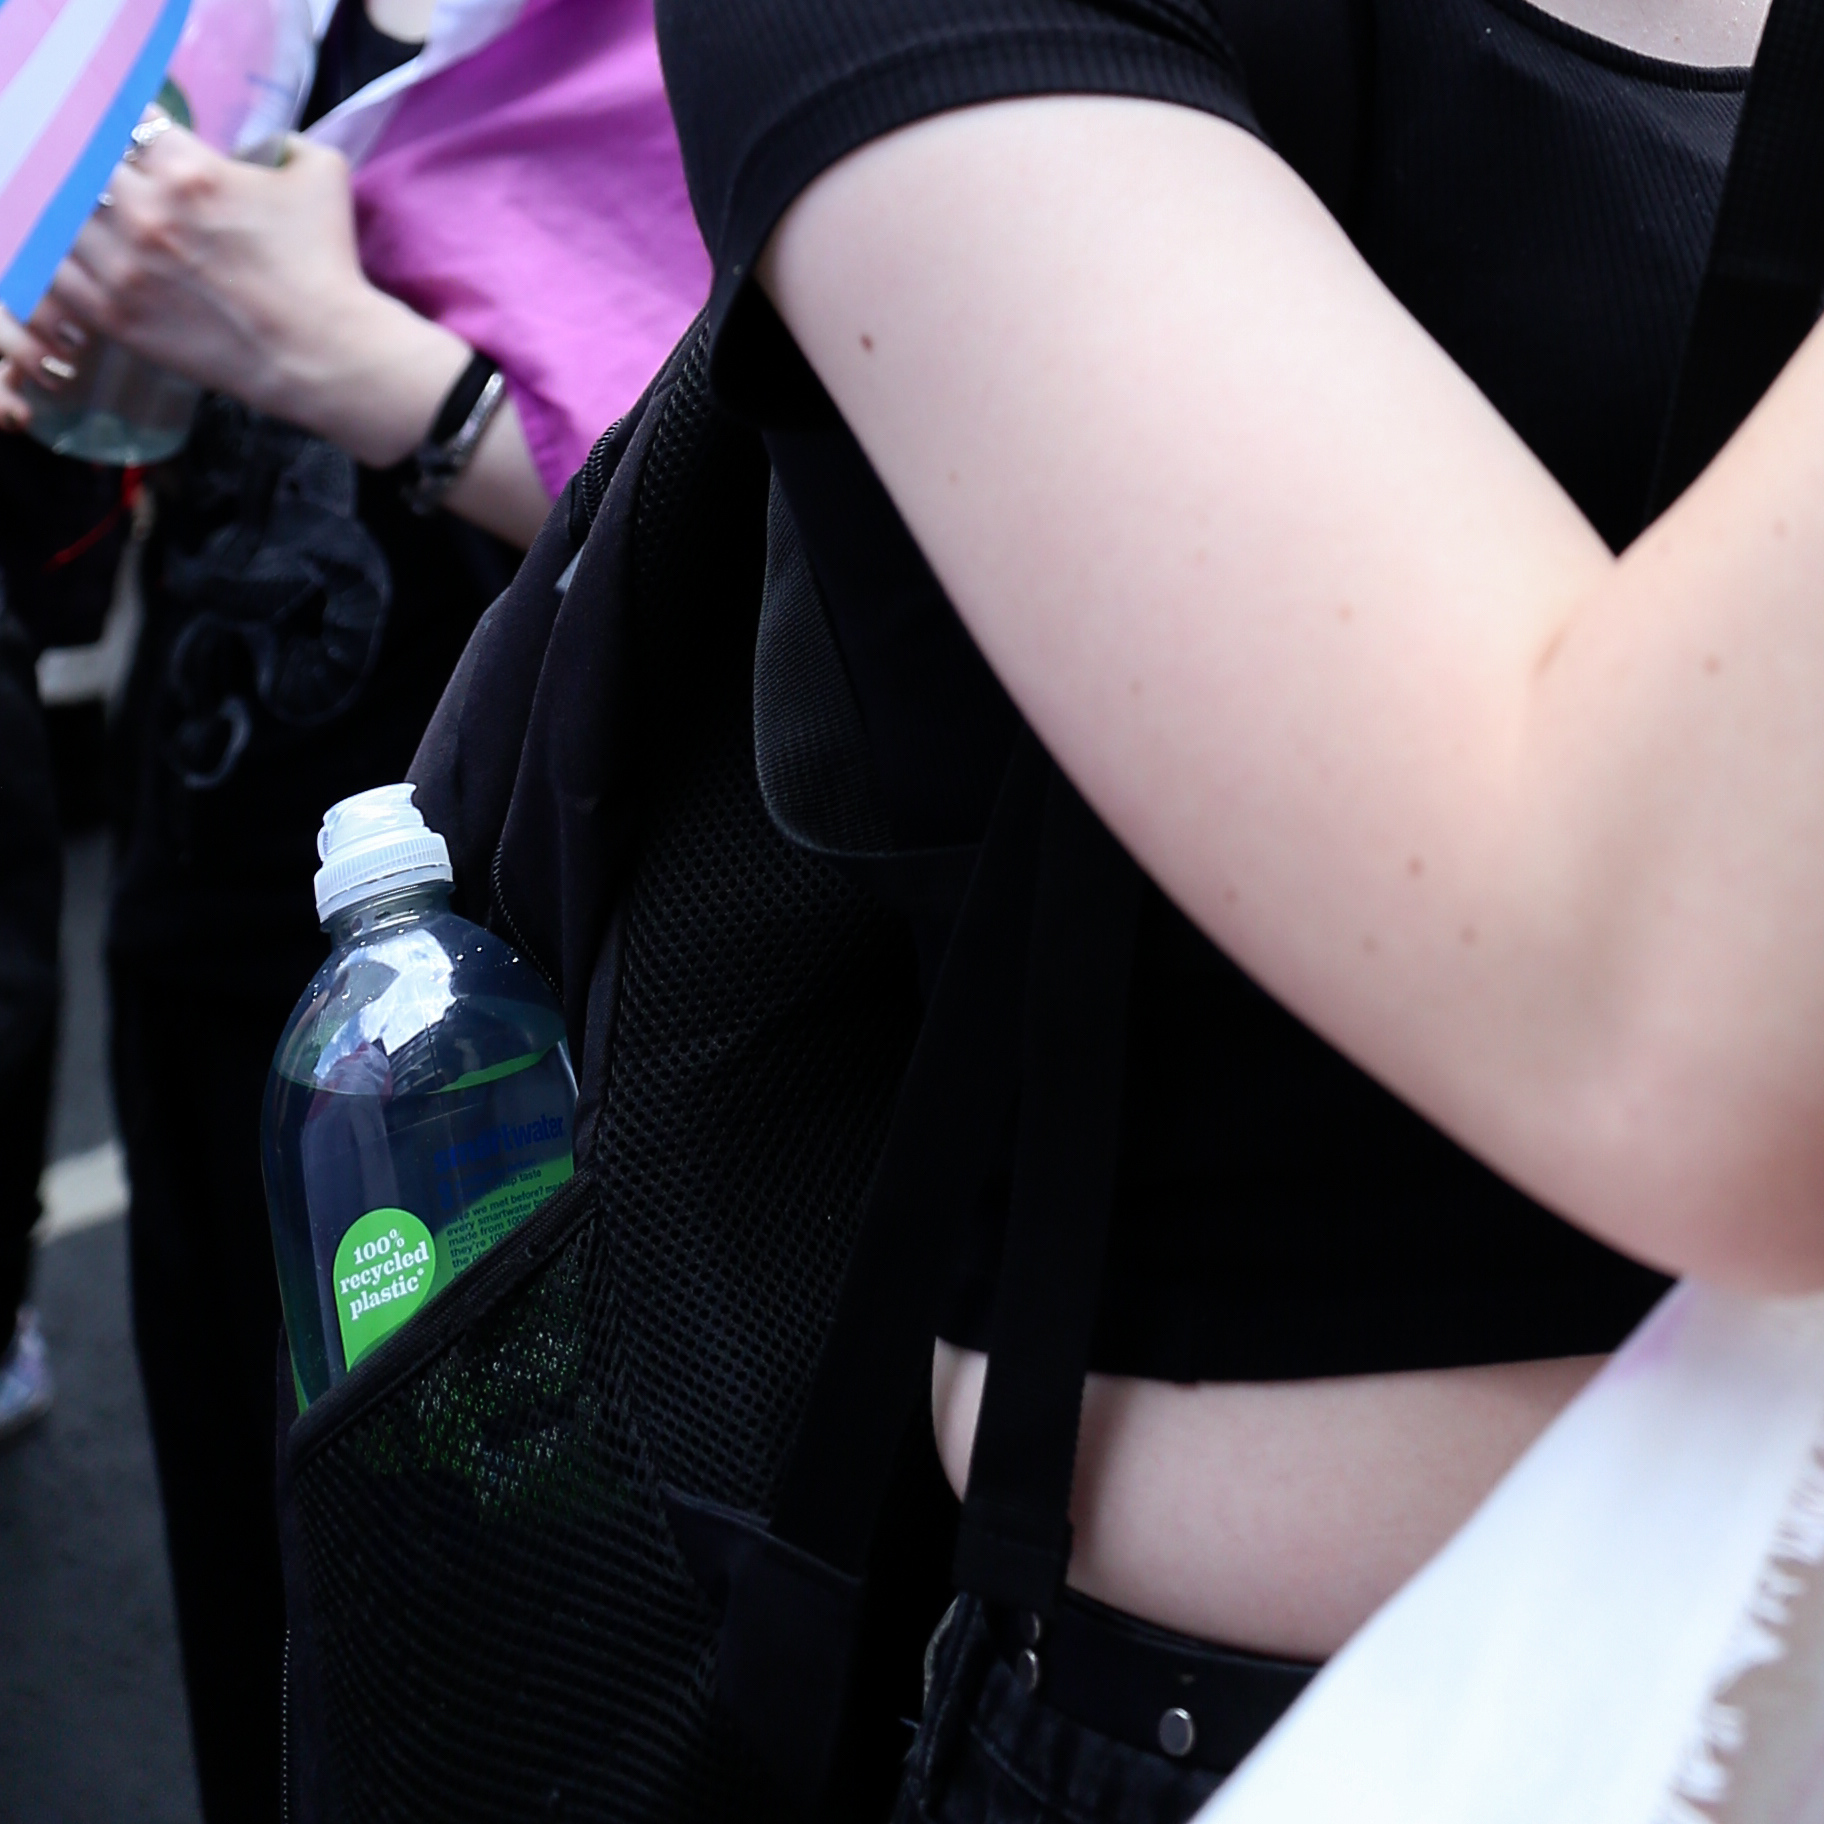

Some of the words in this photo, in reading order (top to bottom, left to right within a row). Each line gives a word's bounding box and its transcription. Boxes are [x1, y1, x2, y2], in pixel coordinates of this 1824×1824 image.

[519, 1168, 542, 1183] taste
[472, 1204, 487, 1217] we
[490, 1197, 509, 1211] met
[510, 1186, 544, 1204] before?
[447, 1221, 475, 1238] every
[478, 1202, 531, 1226] smartwater
[448, 1230, 478, 1248] made
[480, 1220, 505, 1236] from
[353, 1227, 406, 1265] 100%
[450, 1240, 486, 1258] they're
[339, 1239, 430, 1295] recycled
[452, 1254, 469, 1269] the
